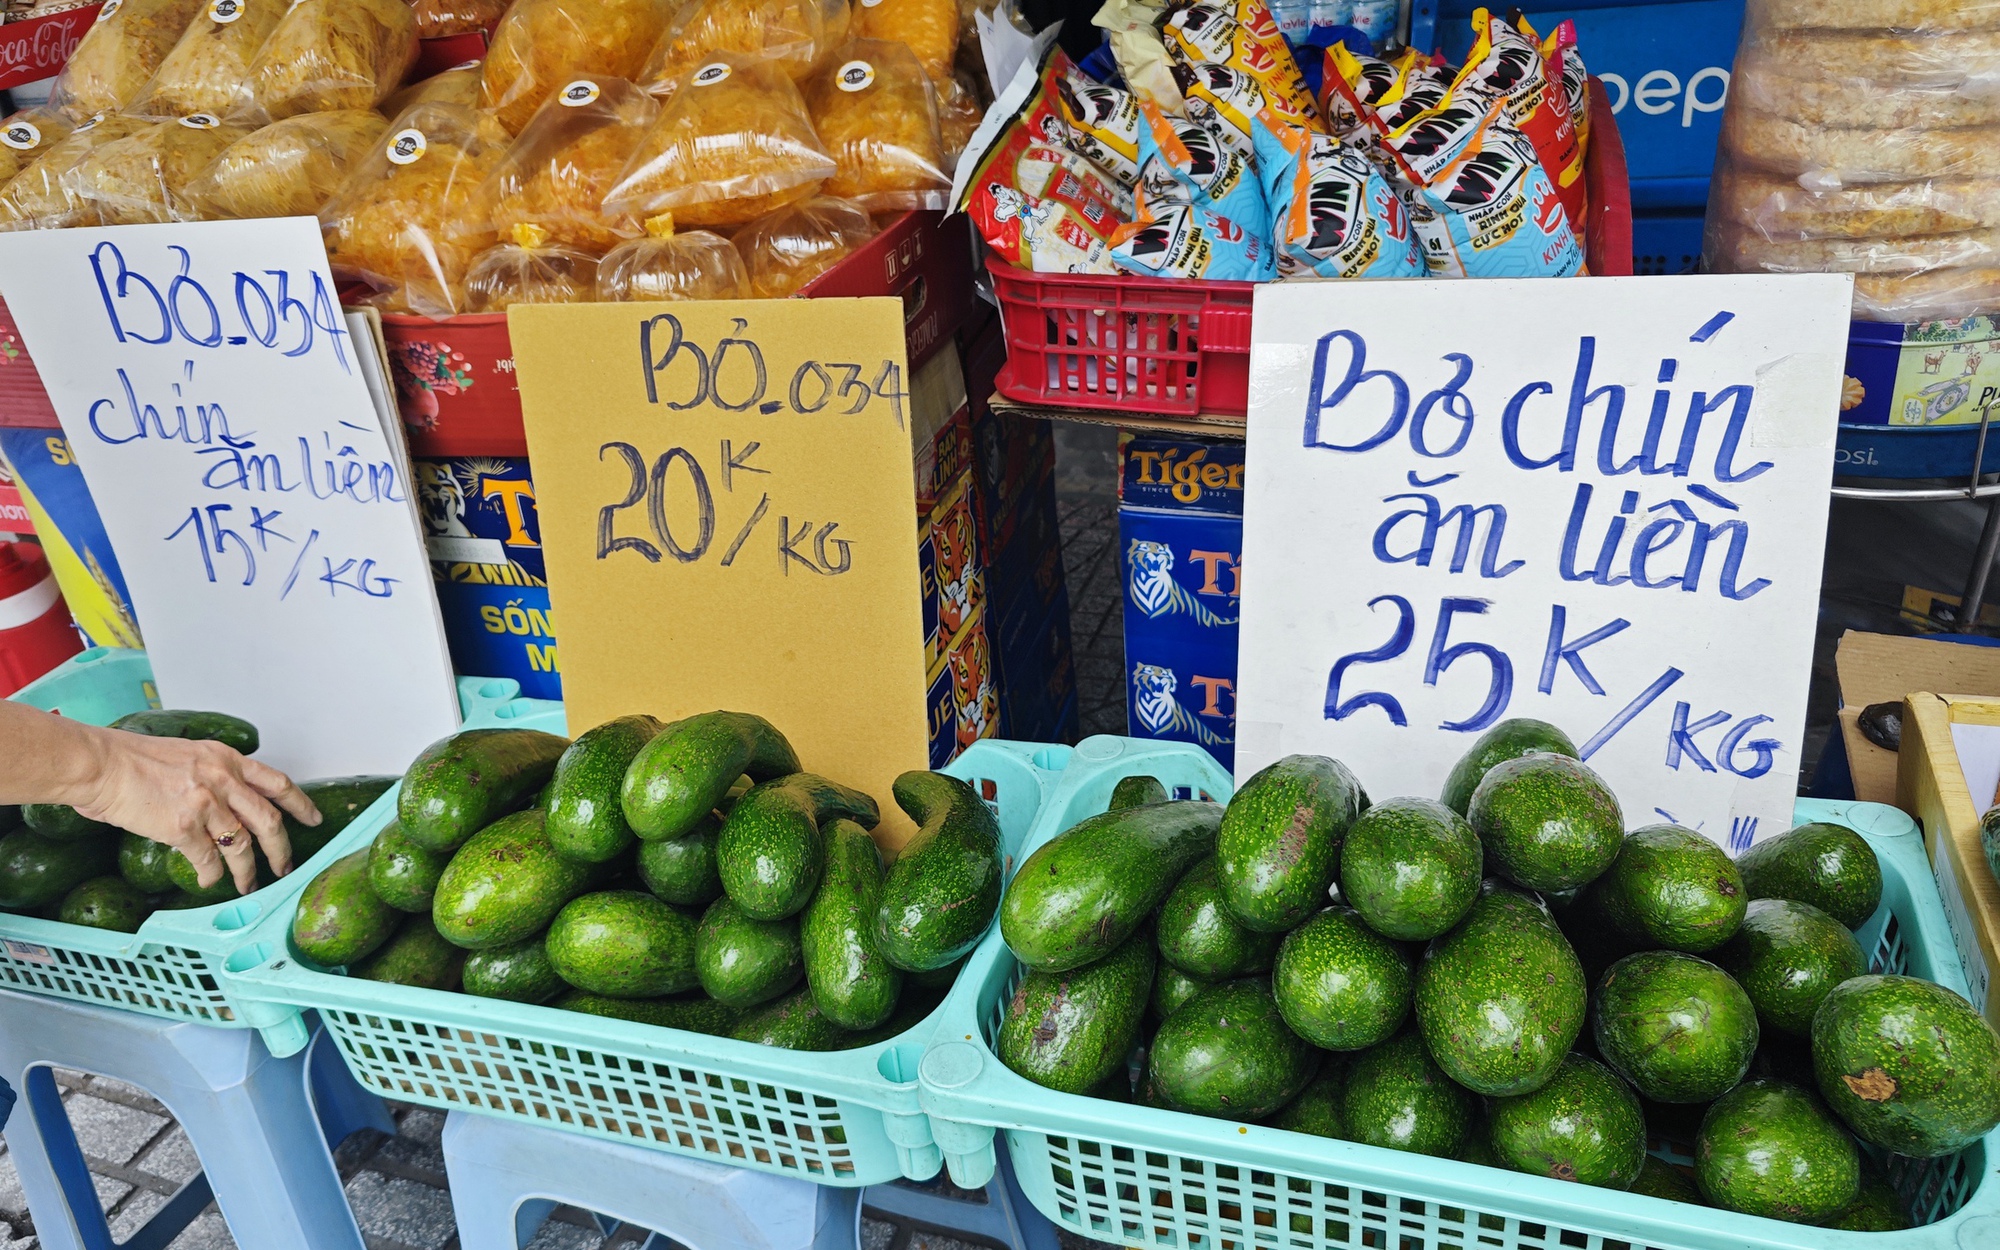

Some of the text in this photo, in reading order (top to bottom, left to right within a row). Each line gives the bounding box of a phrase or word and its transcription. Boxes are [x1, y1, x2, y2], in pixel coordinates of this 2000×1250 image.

[1472, 213, 1525, 249] CỰC HOT
[1478, 209, 1509, 231] RINH
[1429, 237, 1443, 251] 61
[1501, 311, 1774, 482] chín
[1130, 448, 1245, 504] Tiger
[1372, 470, 1774, 600] ăn liền
[480, 597, 556, 638] SỐN
